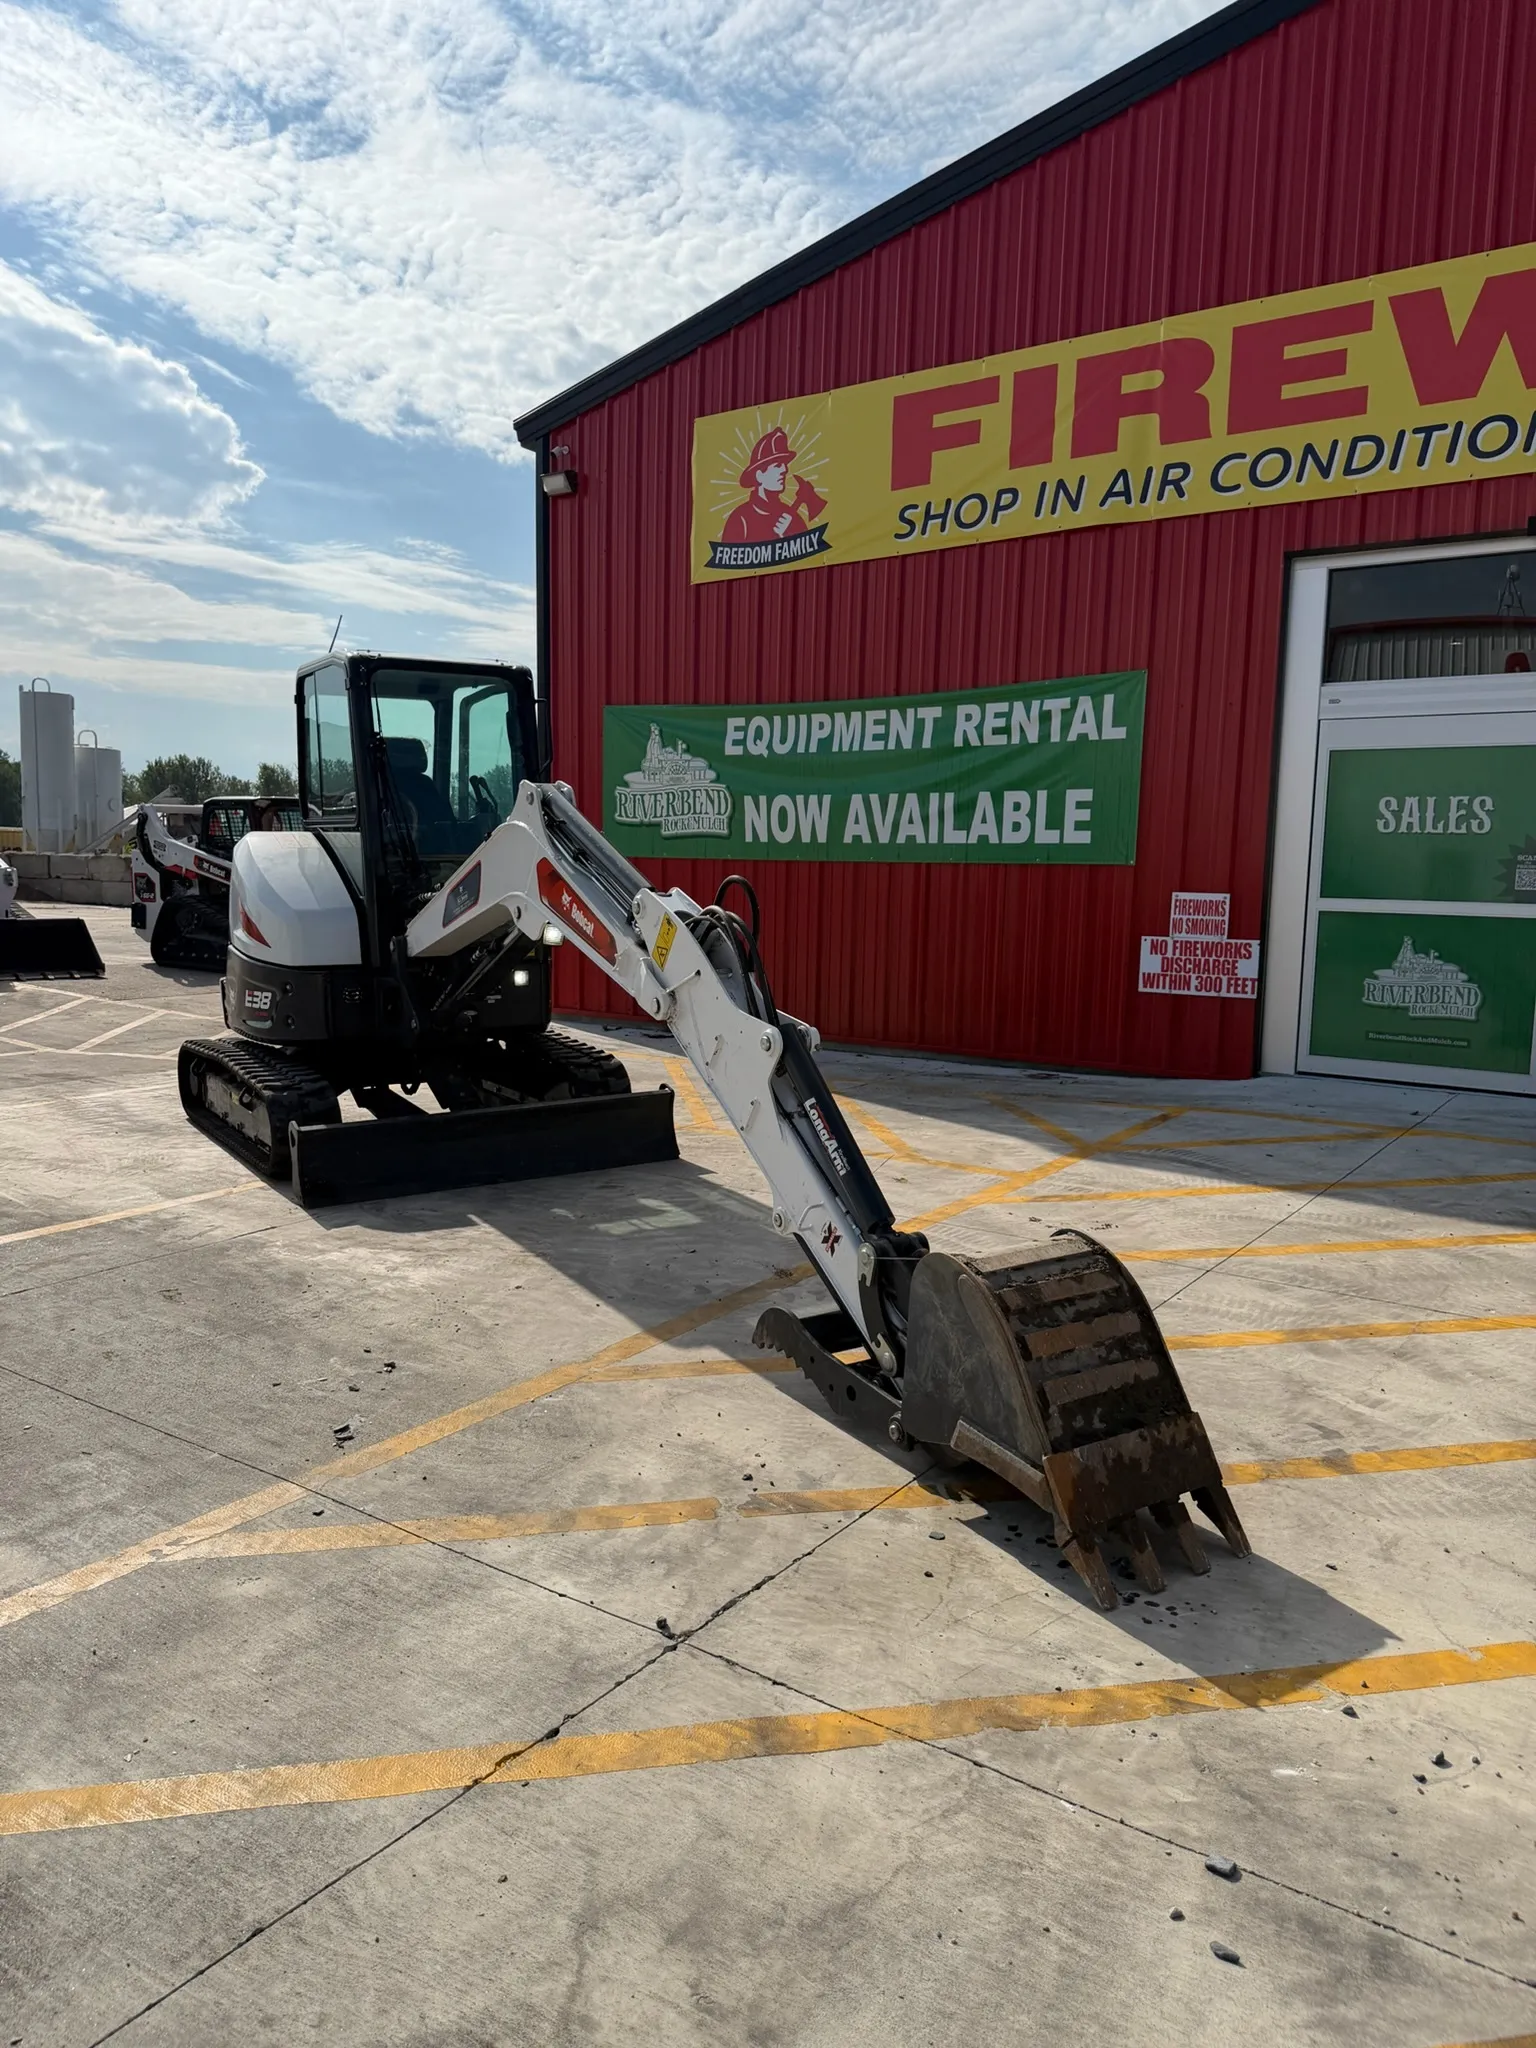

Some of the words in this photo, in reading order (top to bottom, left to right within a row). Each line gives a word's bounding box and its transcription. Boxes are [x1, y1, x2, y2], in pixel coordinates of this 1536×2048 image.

[893, 486, 1019, 541] SHOP
[1034, 474, 1086, 518] IN
[1099, 460, 1193, 509] AIR
[1209, 411, 1536, 495] CONDITIO
[715, 545, 771, 565] FREEDOM
[775, 531, 820, 561] FAMILY
[724, 707, 942, 758] EQUIPMENT
[953, 694, 1127, 748] RENTAL
[617, 788, 730, 819] RIVERBEND
[743, 794, 832, 844] NOW
[843, 788, 1094, 844] AVAILABLE
[1375, 796, 1495, 835] SALES
[571, 903, 595, 938] Bobcat
[1173, 898, 1227, 917] FIREWORKS
[1171, 917, 1183, 934] NO
[1185, 918, 1226, 936] SMOKING
[1149, 938, 1168, 956] NO
[1172, 940, 1252, 960] FIREWORKS
[1161, 957, 1239, 977] DISCHARGE
[1142, 972, 1191, 991] WITHIN
[1195, 975, 1222, 993] 300
[1226, 977, 1258, 995] FEET
[1364, 982, 1480, 1007] RIVERBEND
[245, 989, 272, 1010] E38
